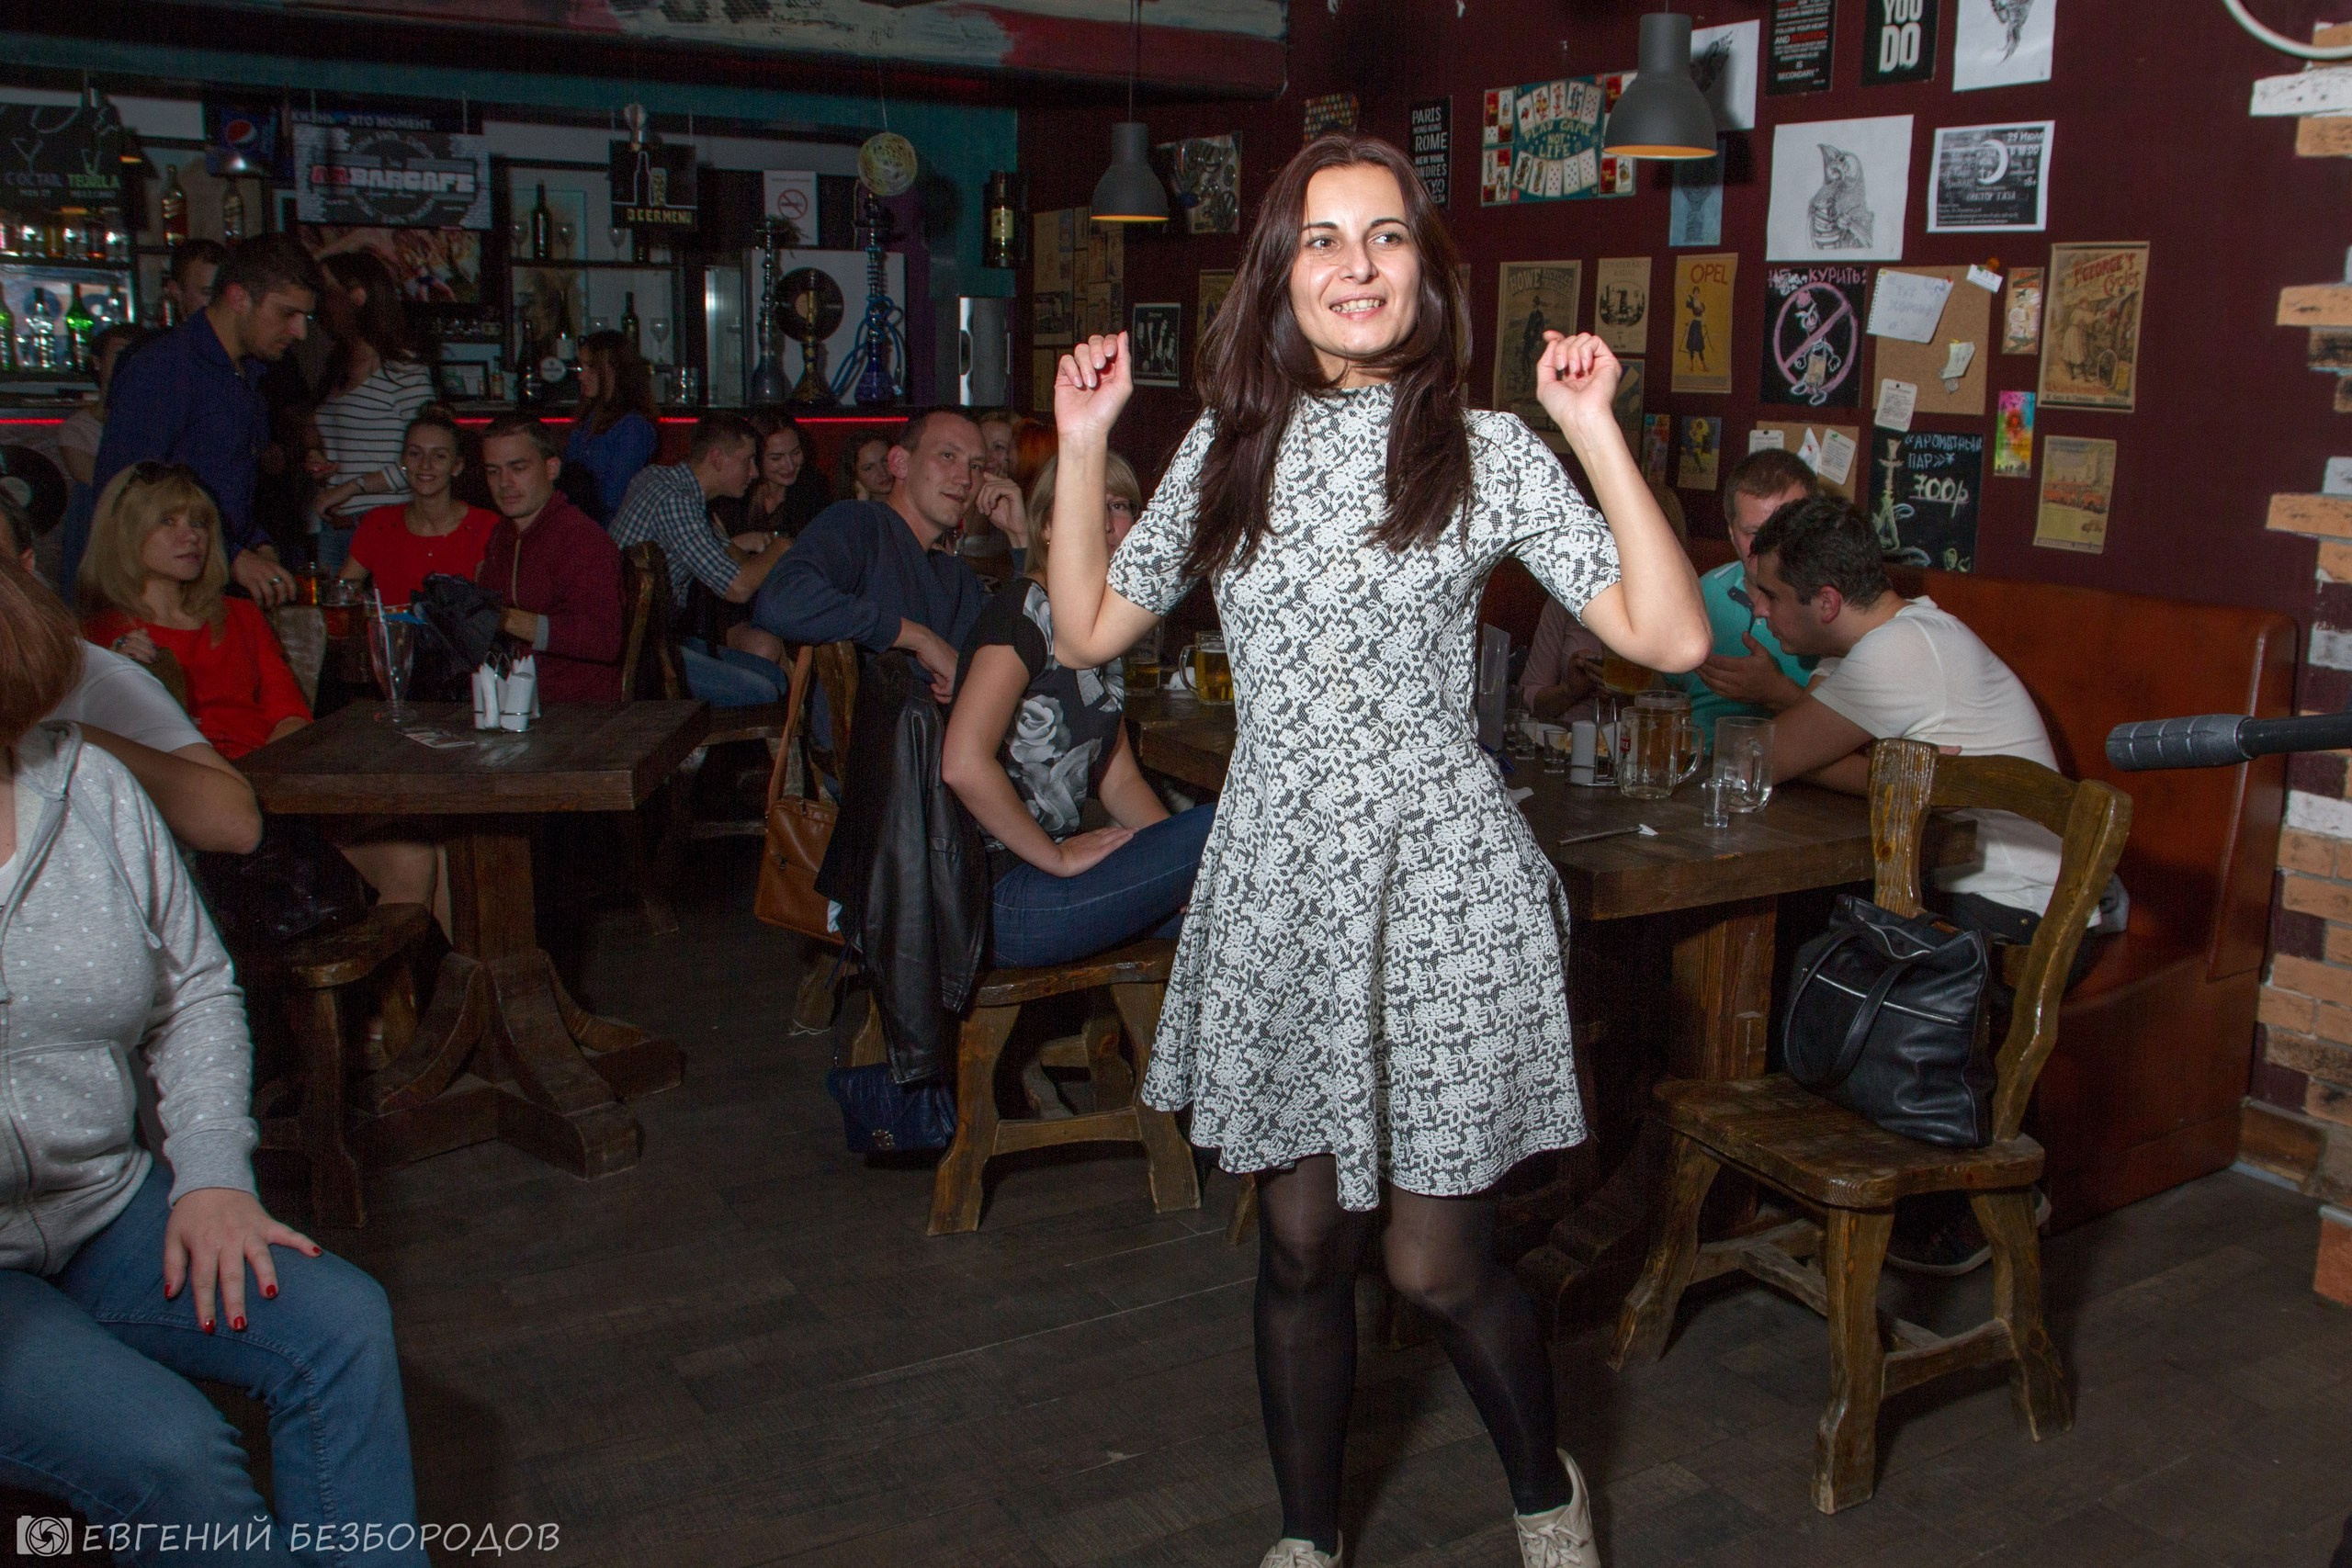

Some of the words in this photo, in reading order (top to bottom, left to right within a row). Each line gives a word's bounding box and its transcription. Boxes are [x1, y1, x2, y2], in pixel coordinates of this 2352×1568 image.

[1775, 35, 1791, 44] AND
[1879, 22, 1921, 73] DO
[1796, 61, 1804, 69] IS
[1412, 107, 1442, 125] PARIS
[1559, 118, 1593, 137] GAME
[1415, 131, 1449, 152] ROME
[1538, 142, 1571, 159] LIFE
[1509, 268, 1542, 294] HOWE
[1690, 263, 1728, 285] OPEL
